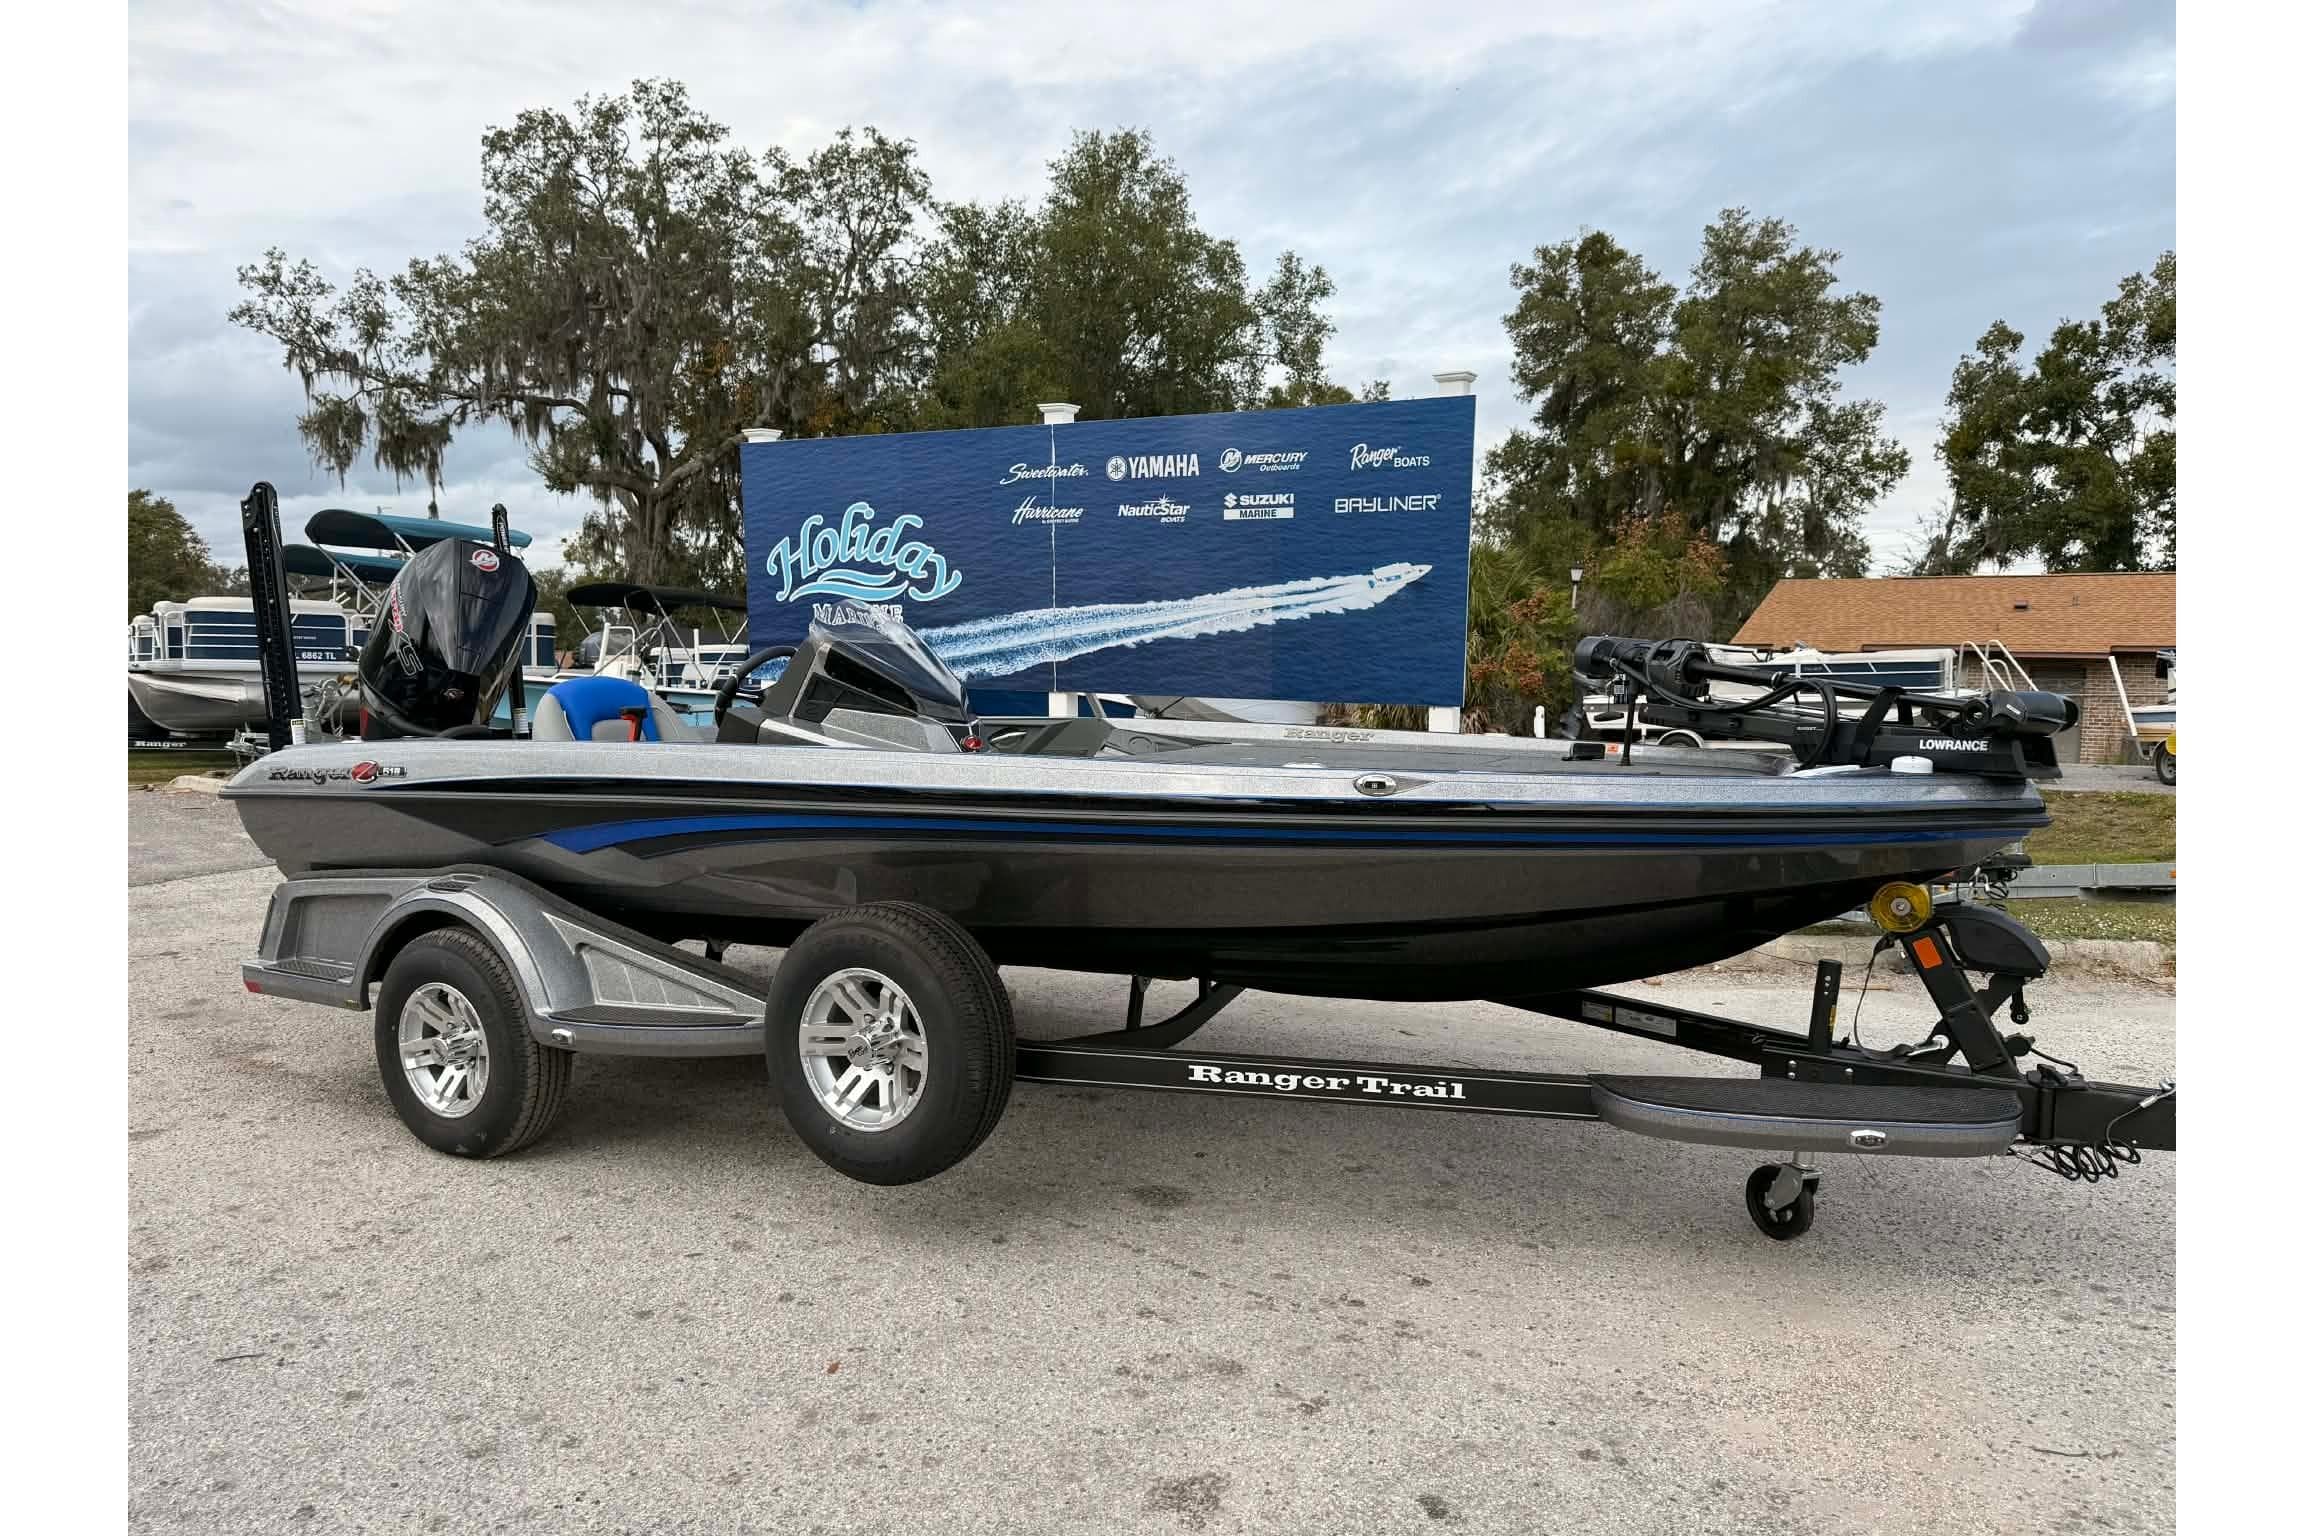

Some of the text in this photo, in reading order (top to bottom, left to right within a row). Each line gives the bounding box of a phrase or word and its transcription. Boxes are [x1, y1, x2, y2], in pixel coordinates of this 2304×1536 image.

[1244, 451, 1308, 465] MERCURY
[1350, 443, 1430, 471] Ranger BOATS
[1000, 463, 1088, 485] Sweetwater
[1128, 454, 1200, 479] YAMAHA
[1259, 464, 1300, 472] Outboards
[1240, 493, 1294, 506] SUZUKI
[1335, 495, 1437, 513] BAYLINER
[1011, 496, 1084, 526] Hurricane
[1118, 503, 1191, 517] NauticStar
[1239, 509, 1277, 518] MARINE
[767, 501, 962, 602] Holiday
[324, 652, 337, 660] TL
[1919, 739, 1989, 751] LOWRANCE
[1188, 1064, 1467, 1099] Ranger Trail
